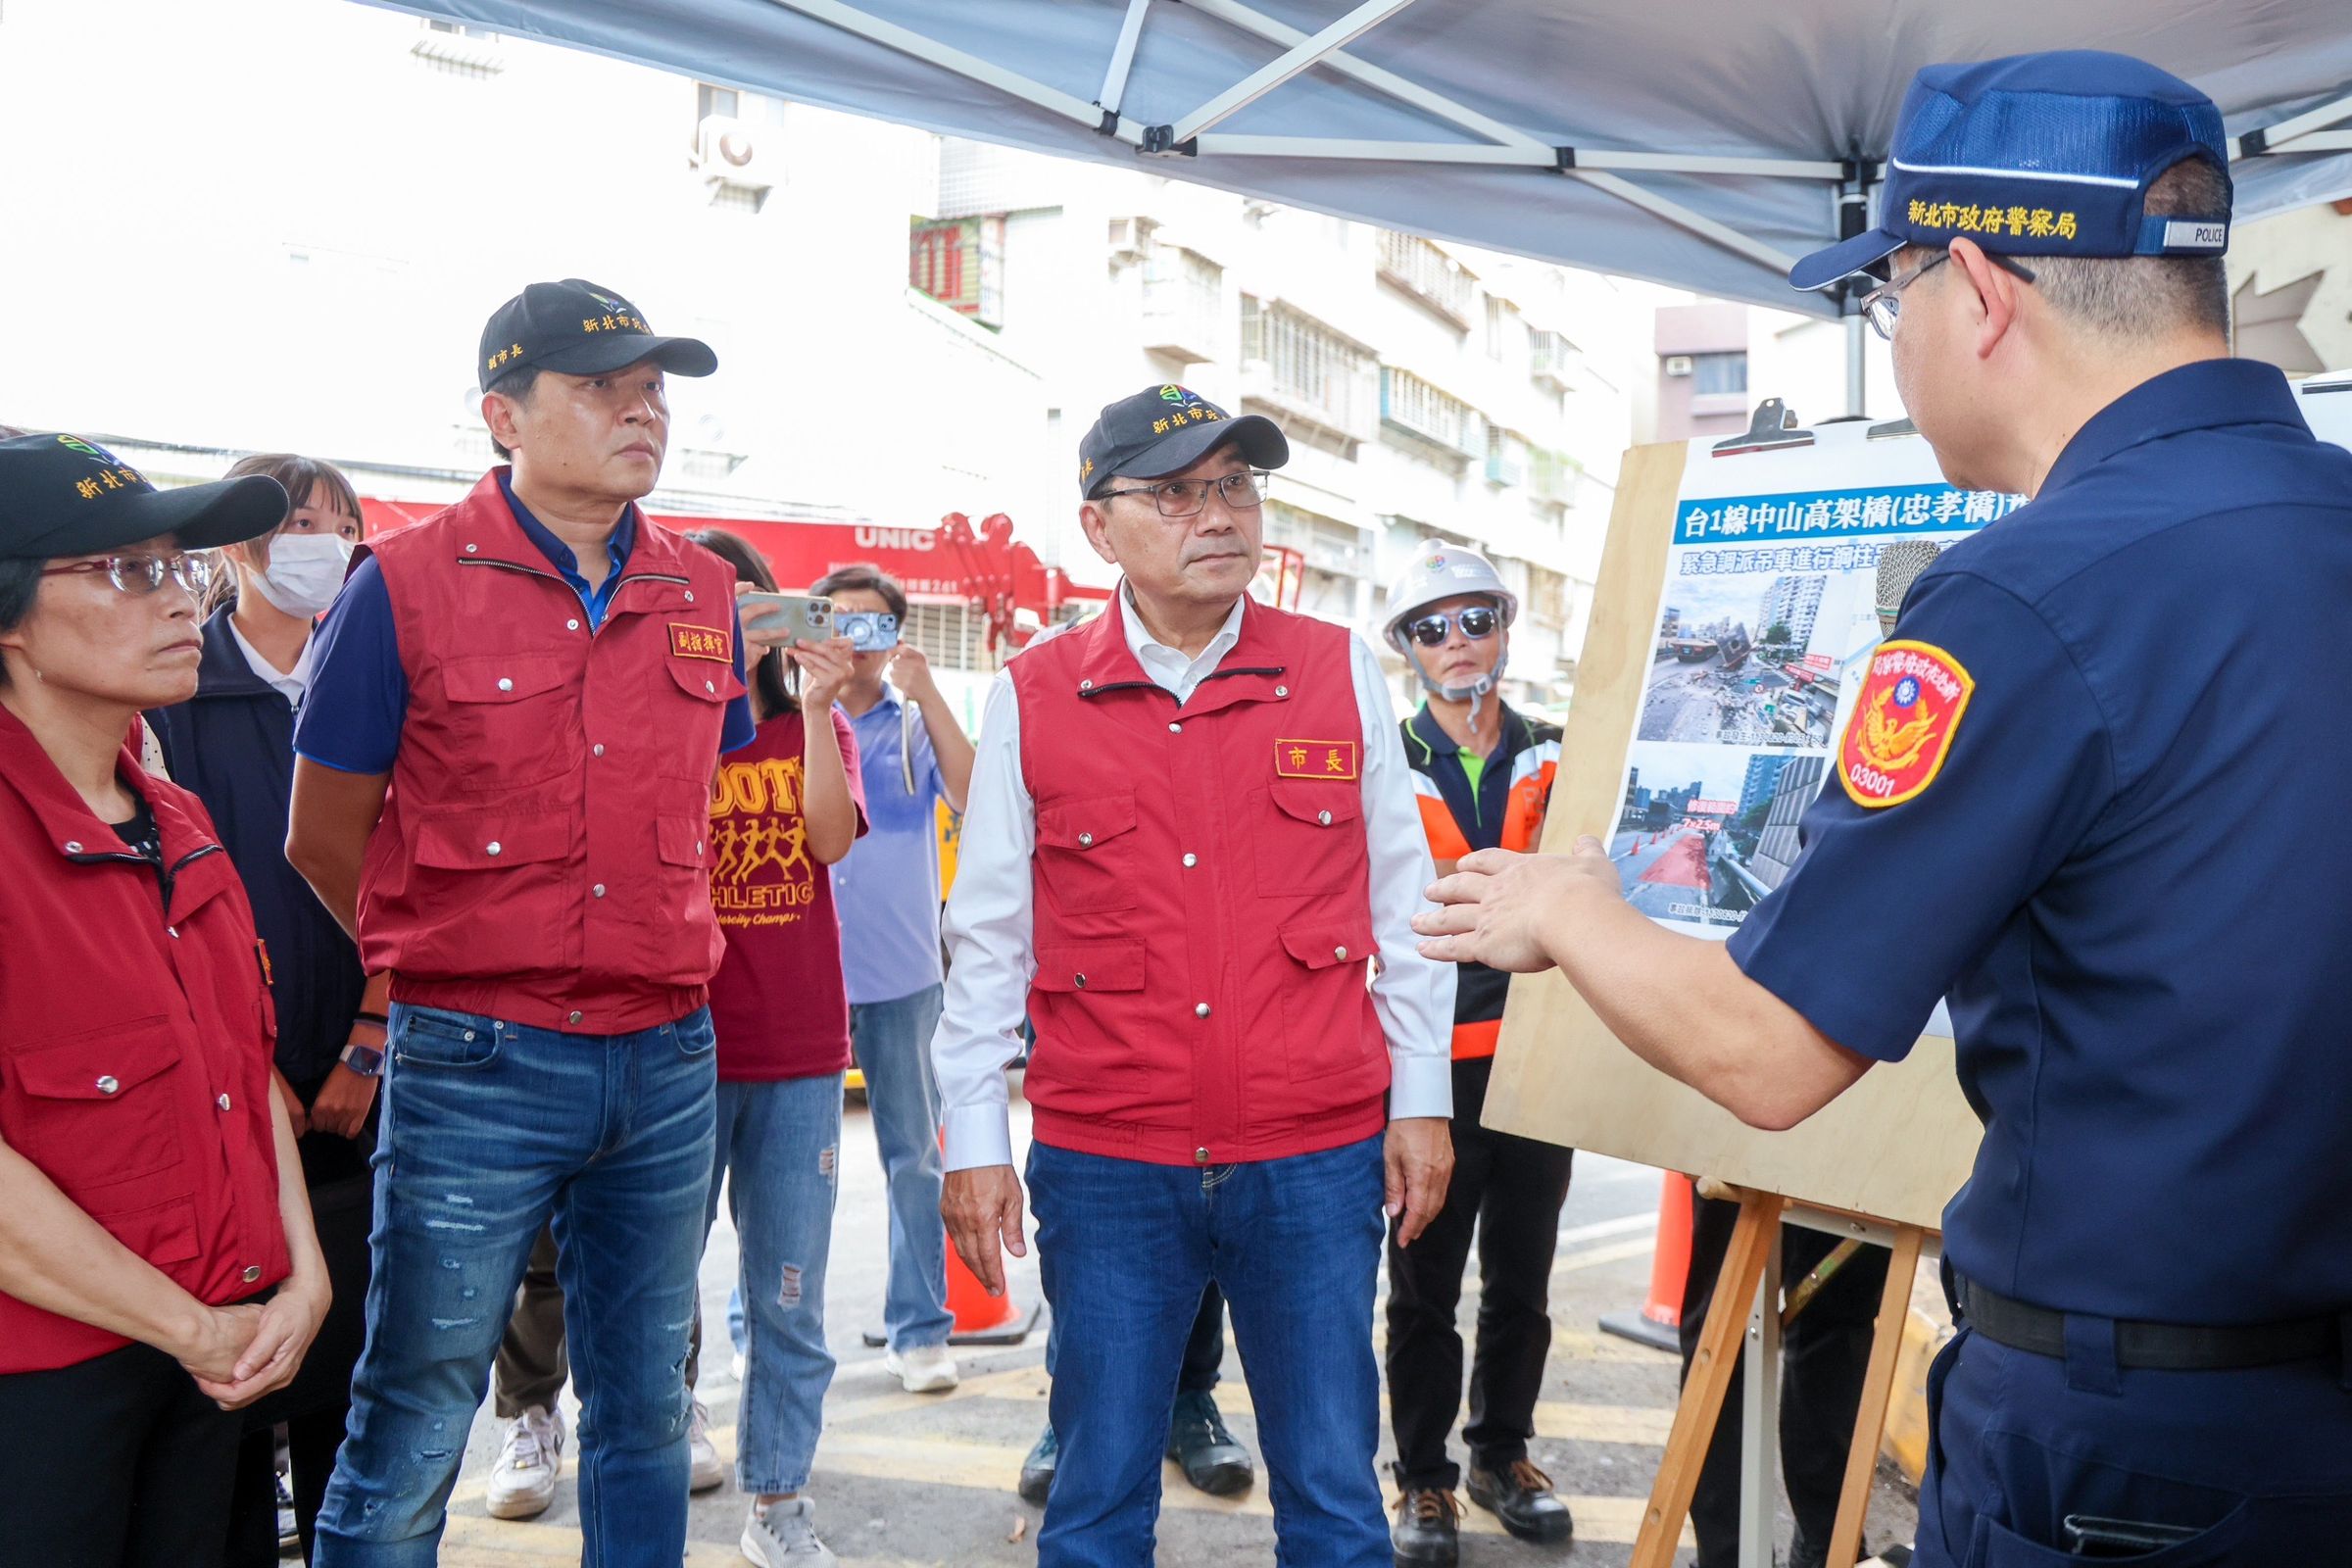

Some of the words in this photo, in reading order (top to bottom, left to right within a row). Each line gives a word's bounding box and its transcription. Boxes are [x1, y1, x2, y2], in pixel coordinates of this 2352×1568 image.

[1908, 198, 2079, 240] 新北市政府警察局
[2194, 227, 2223, 243] POLICE
[488, 342, 524, 370] 副市長
[1152, 407, 1227, 434] 新北市政
[855, 527, 936, 551] UNIC
[678, 631, 723, 656] 副指揮官
[1288, 746, 1345, 772] 市長
[710, 755, 805, 818] OOT
[1850, 762, 1896, 798] 03001
